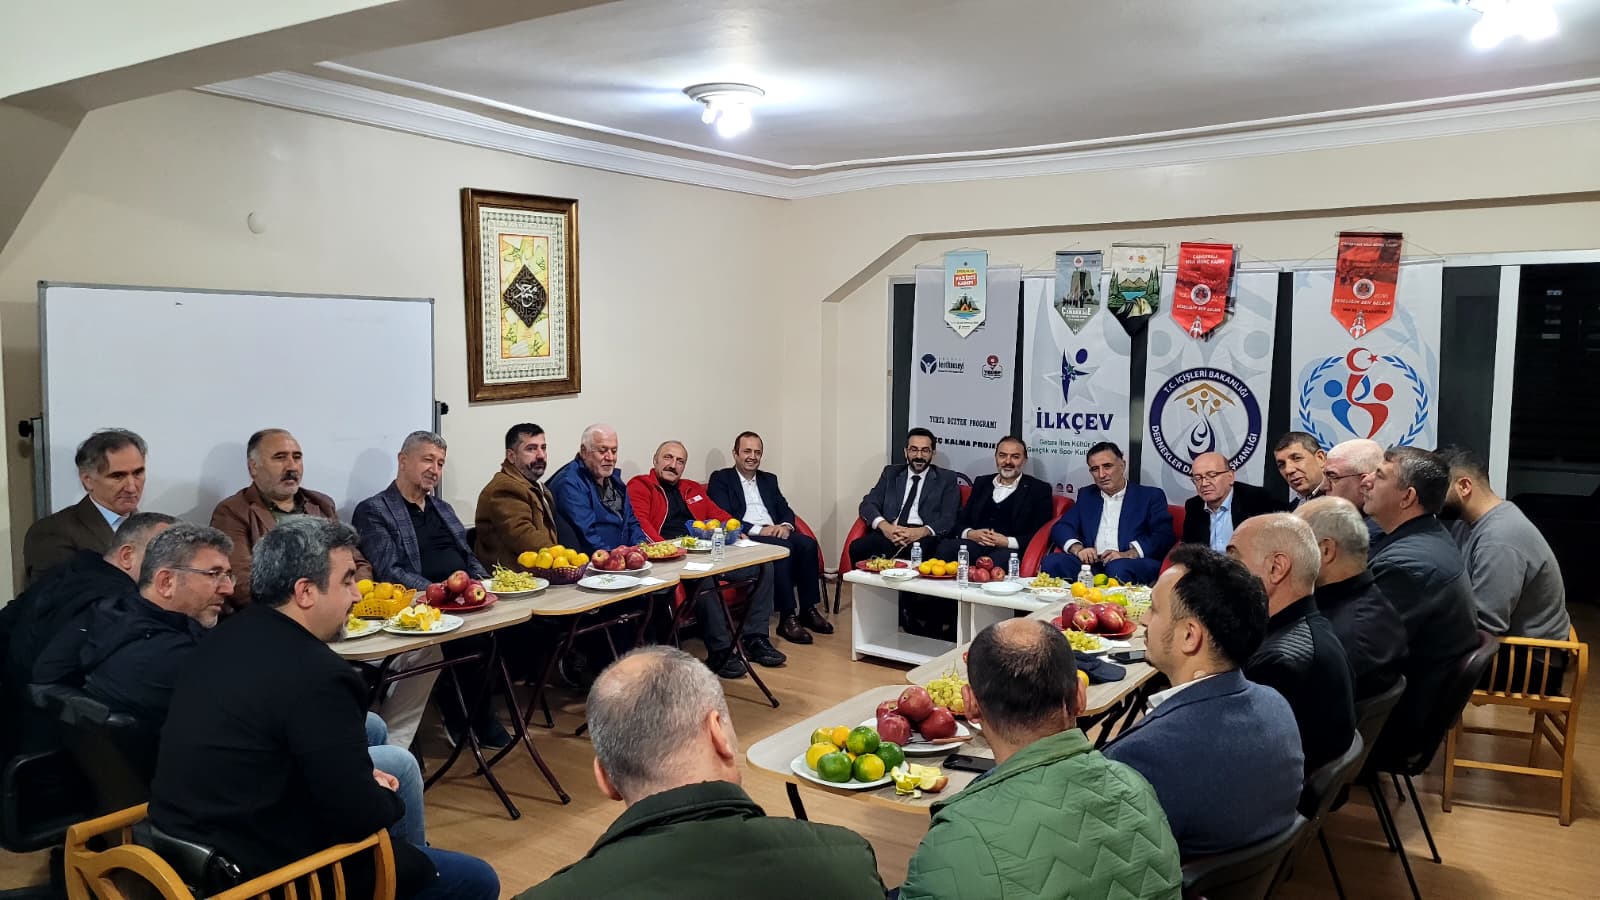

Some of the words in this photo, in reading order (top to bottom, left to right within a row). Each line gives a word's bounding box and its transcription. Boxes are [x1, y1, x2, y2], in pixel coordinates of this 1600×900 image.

[1163, 383, 1177, 393] T.C.
[1176, 369, 1207, 384] İÇİŞLERİ
[1208, 370, 1249, 398] BAKANLIĞI
[1036, 406, 1114, 435] İLKÇEV
[944, 438, 971, 447] KALMA
[1151, 425, 1182, 470] DERNEKLER
